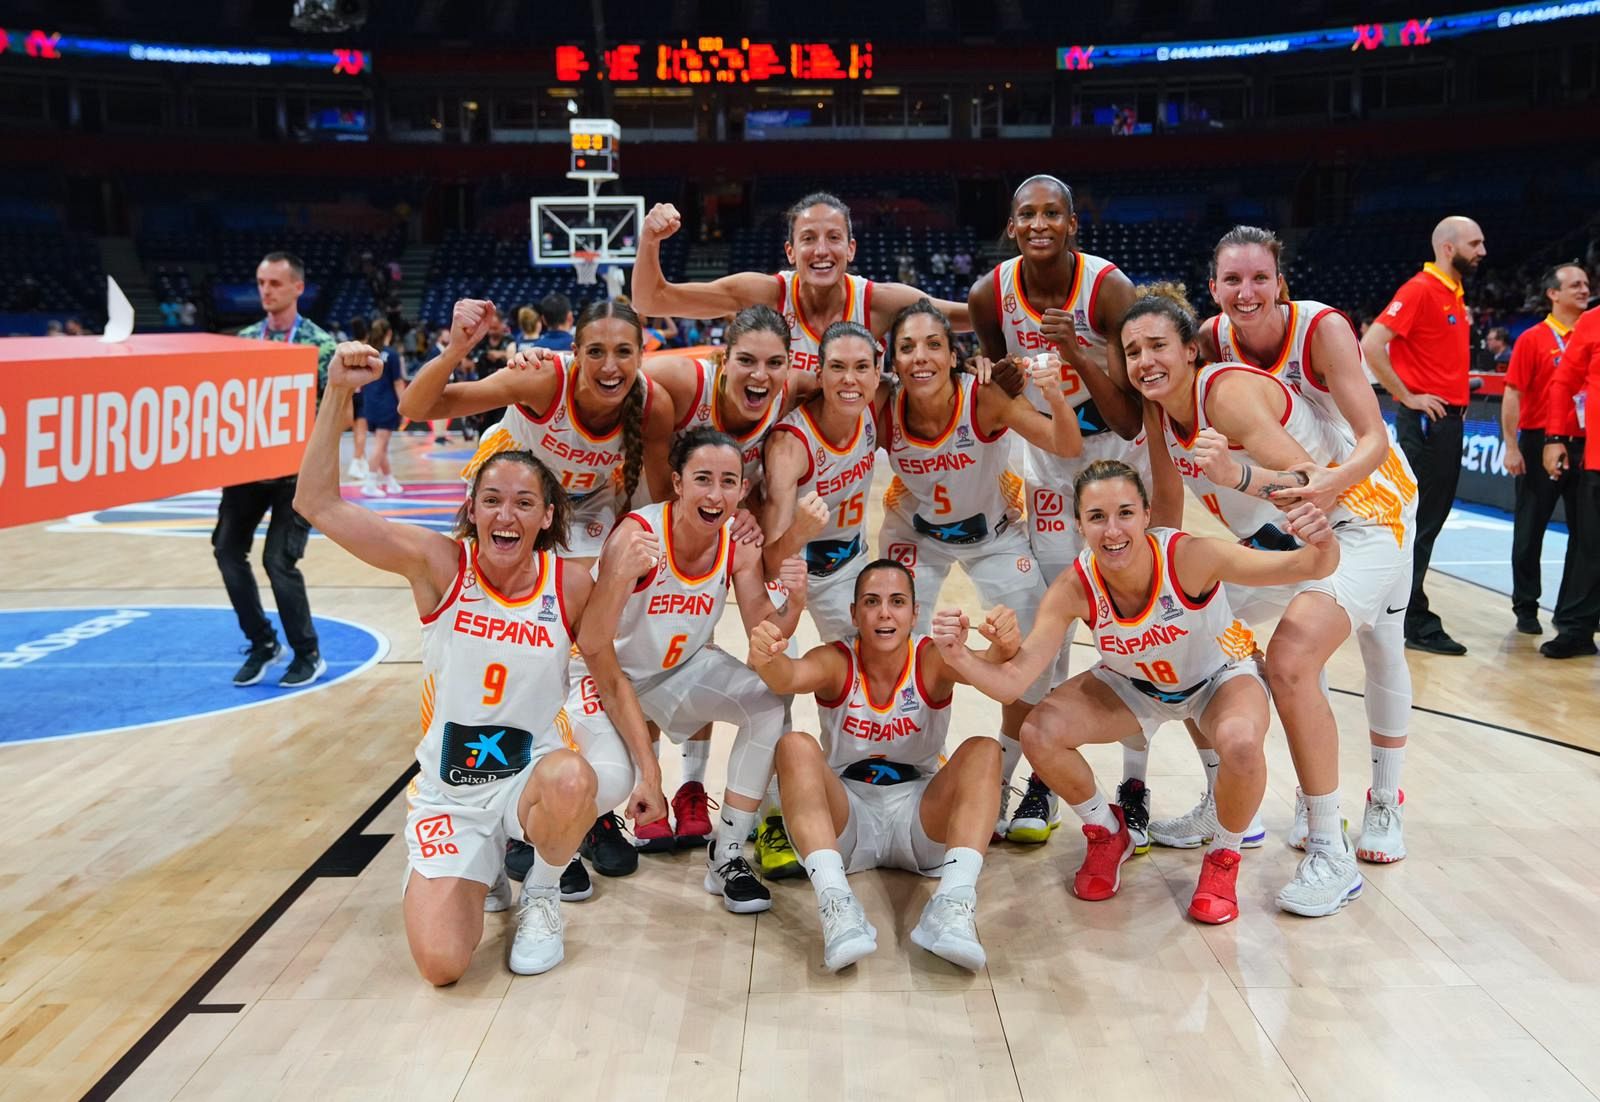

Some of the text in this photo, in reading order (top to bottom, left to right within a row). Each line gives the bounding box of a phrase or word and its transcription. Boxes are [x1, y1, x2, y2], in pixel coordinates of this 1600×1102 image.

[25, 373, 315, 488] EUROBASKET
[540, 434, 623, 466] ESPAÑA
[898, 451, 976, 475] ESPAÑA
[816, 450, 875, 497] ESPAÑA
[836, 491, 864, 528] 15
[933, 483, 952, 515] 5
[647, 592, 715, 616] ESPAÑ
[453, 609, 554, 649] ESPAÑA
[1099, 622, 1189, 656] ESPAÑA
[661, 633, 688, 670] 6
[481, 661, 508, 706] 9
[1134, 659, 1180, 686] 18
[842, 714, 922, 742] ESPAÑA
